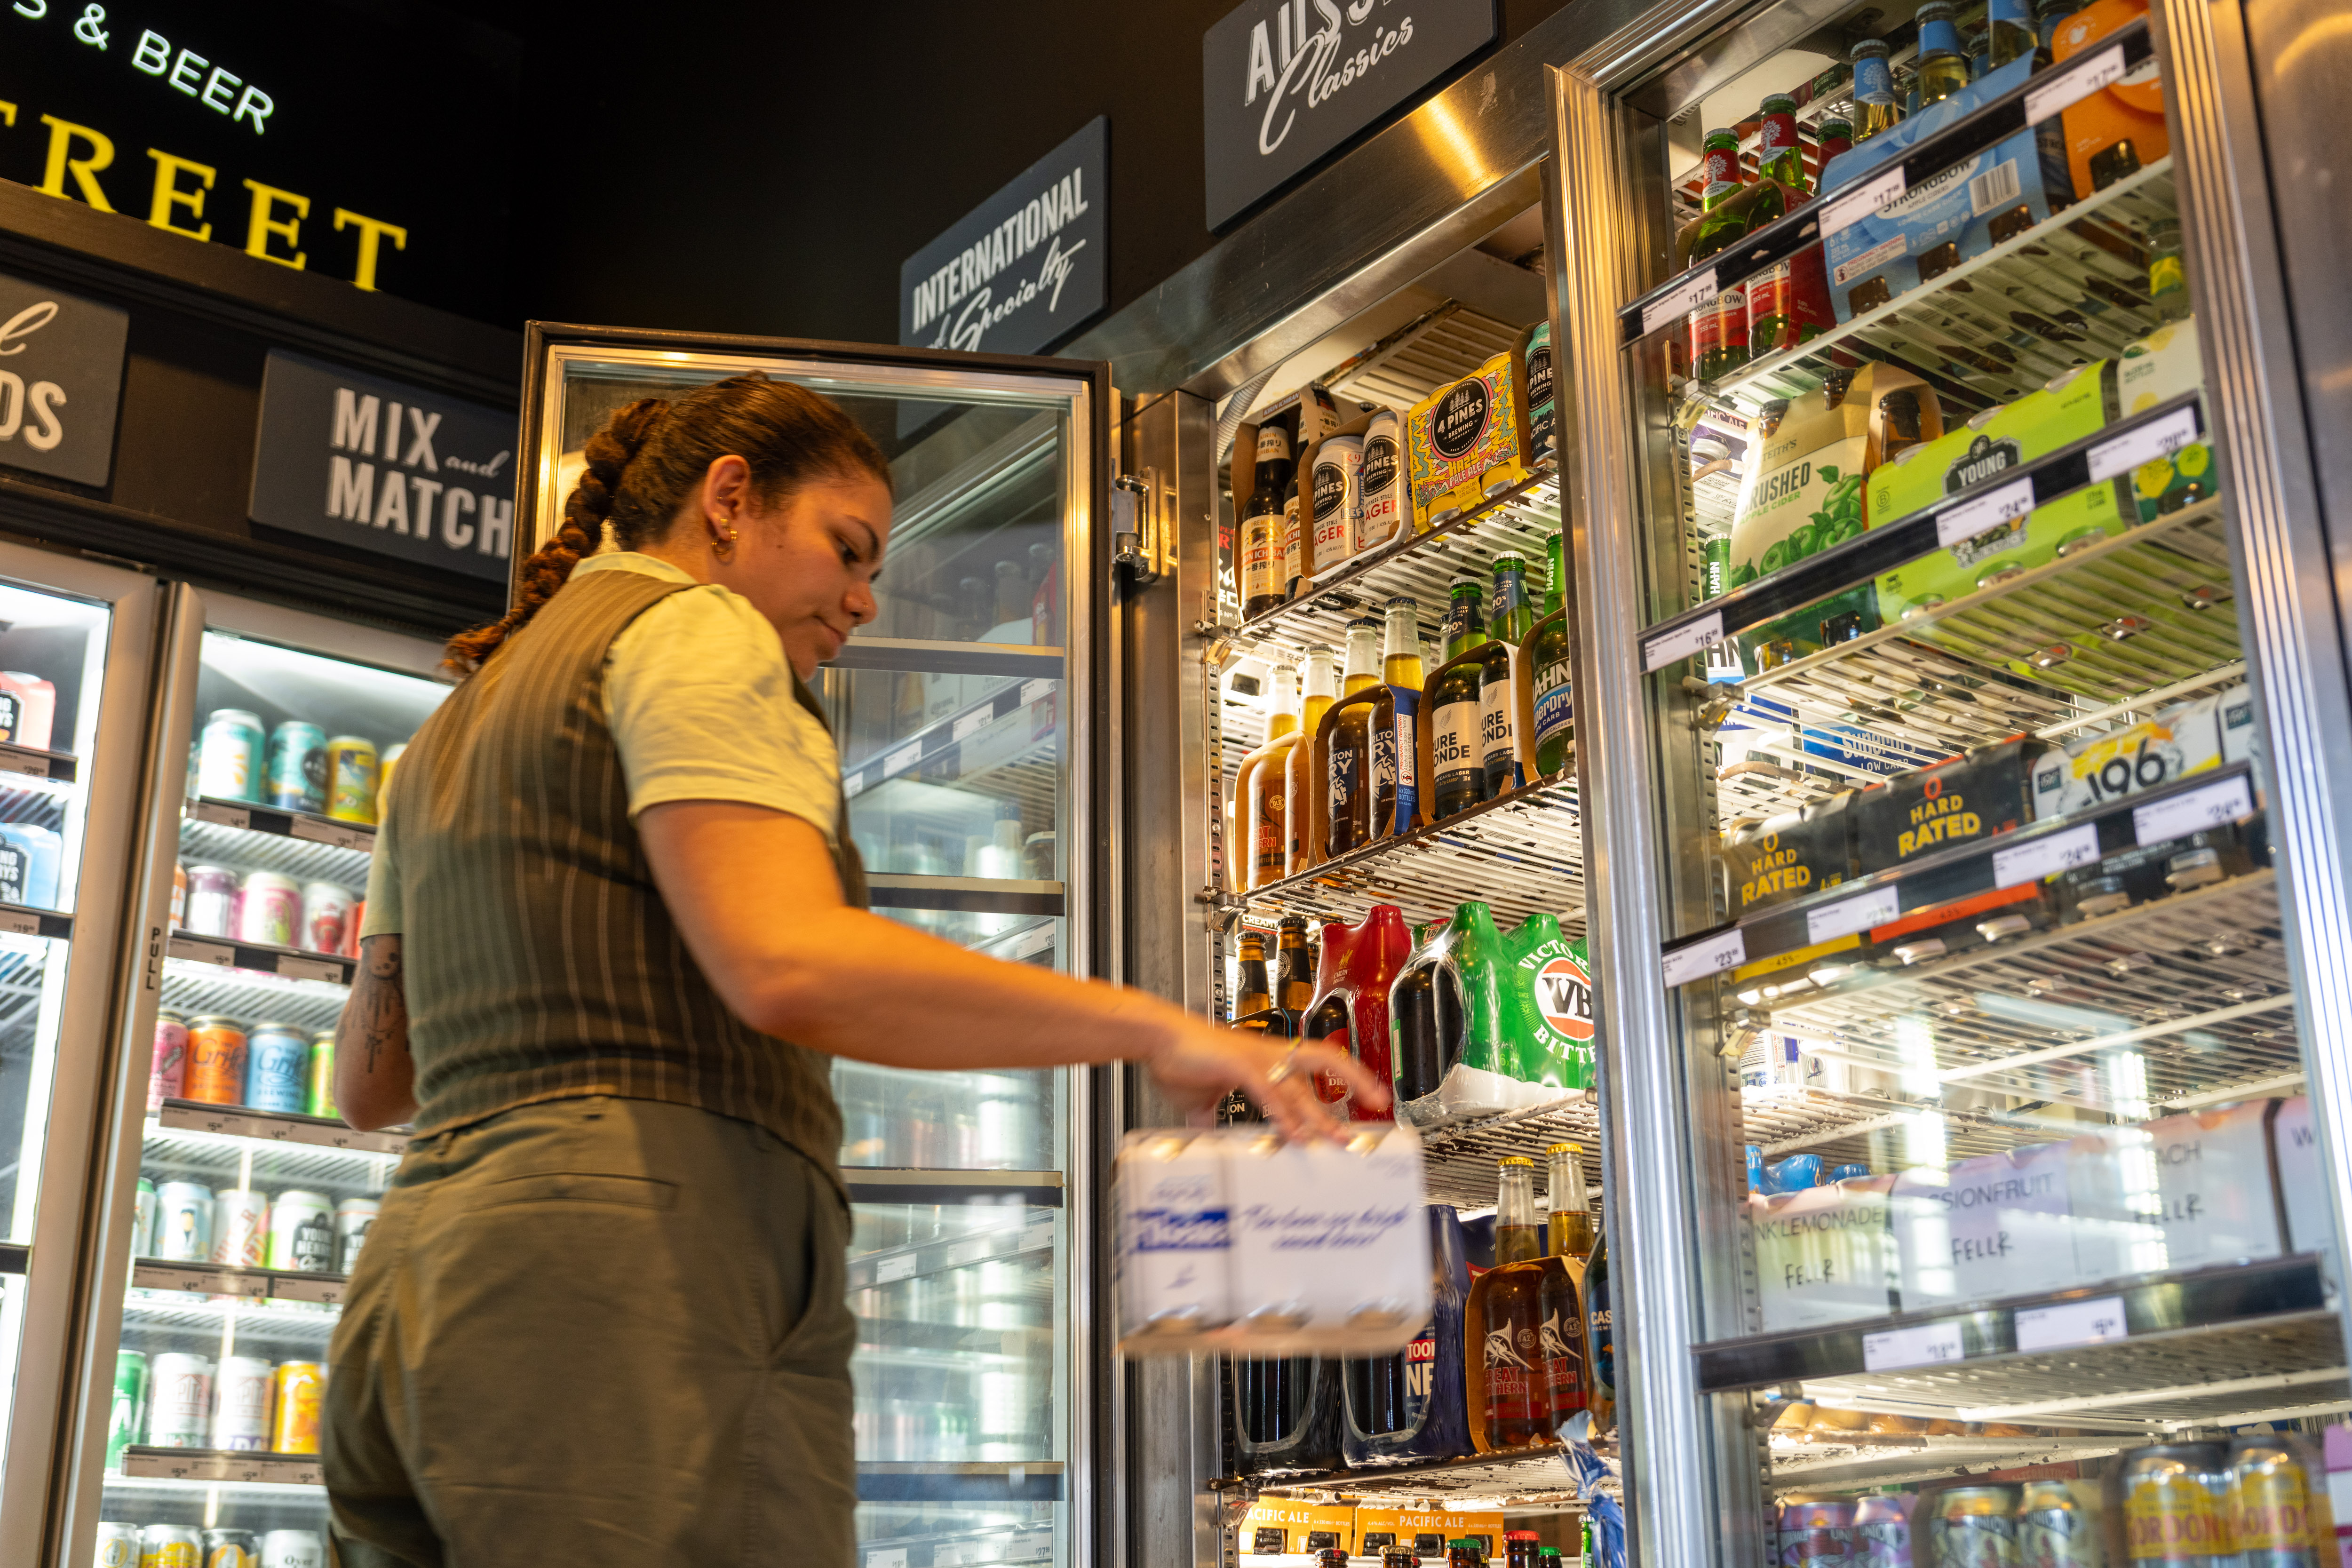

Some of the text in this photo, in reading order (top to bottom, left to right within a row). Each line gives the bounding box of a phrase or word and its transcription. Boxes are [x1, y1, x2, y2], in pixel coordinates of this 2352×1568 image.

[74, 3, 274, 135] & BEER
[1259, 16, 1413, 155] Classics
[912, 161, 1089, 335] INTERNATIONAL
[1529, 367, 1552, 389] PINE
[1530, 381, 1551, 397] BREWING
[1263, 403, 1278, 416] KIRIN
[1438, 398, 1483, 433] 4 PINES
[330, 387, 510, 478] MIX and
[1448, 420, 1473, 439] BREWING
[1452, 429, 1470, 441] COMPANY
[1367, 454, 1398, 475] PINES
[1447, 449, 1479, 477] HAZY
[1449, 461, 1482, 487] PALE ALE
[1957, 451, 2007, 488] YOUNG
[1367, 469, 1387, 481] BREWING
[1368, 475, 1383, 484] COMPANY
[1314, 481, 1343, 501] PINES
[1314, 495, 1333, 508] BREWING
[1772, 491, 1801, 509] CIDER
[326, 455, 513, 558] MATCH
[1365, 499, 1400, 526] AGER
[1314, 525, 1345, 547] AGER
[1546, 557, 1554, 592] HAHN
[1709, 561, 1720, 595] HAHN
[1492, 595, 1507, 609] 90%
[1448, 621, 1462, 634] 90%
[1481, 709, 1504, 732] URE
[1542, 711, 1560, 725] CARB
[1550, 720, 1571, 732] CALORIES
[1372, 740, 1396, 759] RY
[1434, 731, 1457, 752] URE
[1434, 745, 1470, 768] ONDE
[1861, 763, 1881, 772] LOW
[1328, 758, 1353, 781] RY
[1398, 793, 1415, 803] BOTTLES
[1910, 795, 1963, 825] HARD
[1898, 812, 1981, 857] RATED
[1751, 848, 1797, 876] HARD
[1741, 865, 1811, 907] RATED
[146, 926, 162, 990] PULL
[1518, 939, 1590, 973] VICTOR
[1542, 977, 1593, 1019] VB
[1780, 1204, 1884, 1238] LEMONADE
[1247, 1507, 1310, 1524] ACIFIC ALE
[1399, 1515, 1443, 1528] PACIFIC
[1444, 1516, 1464, 1528] ALE
